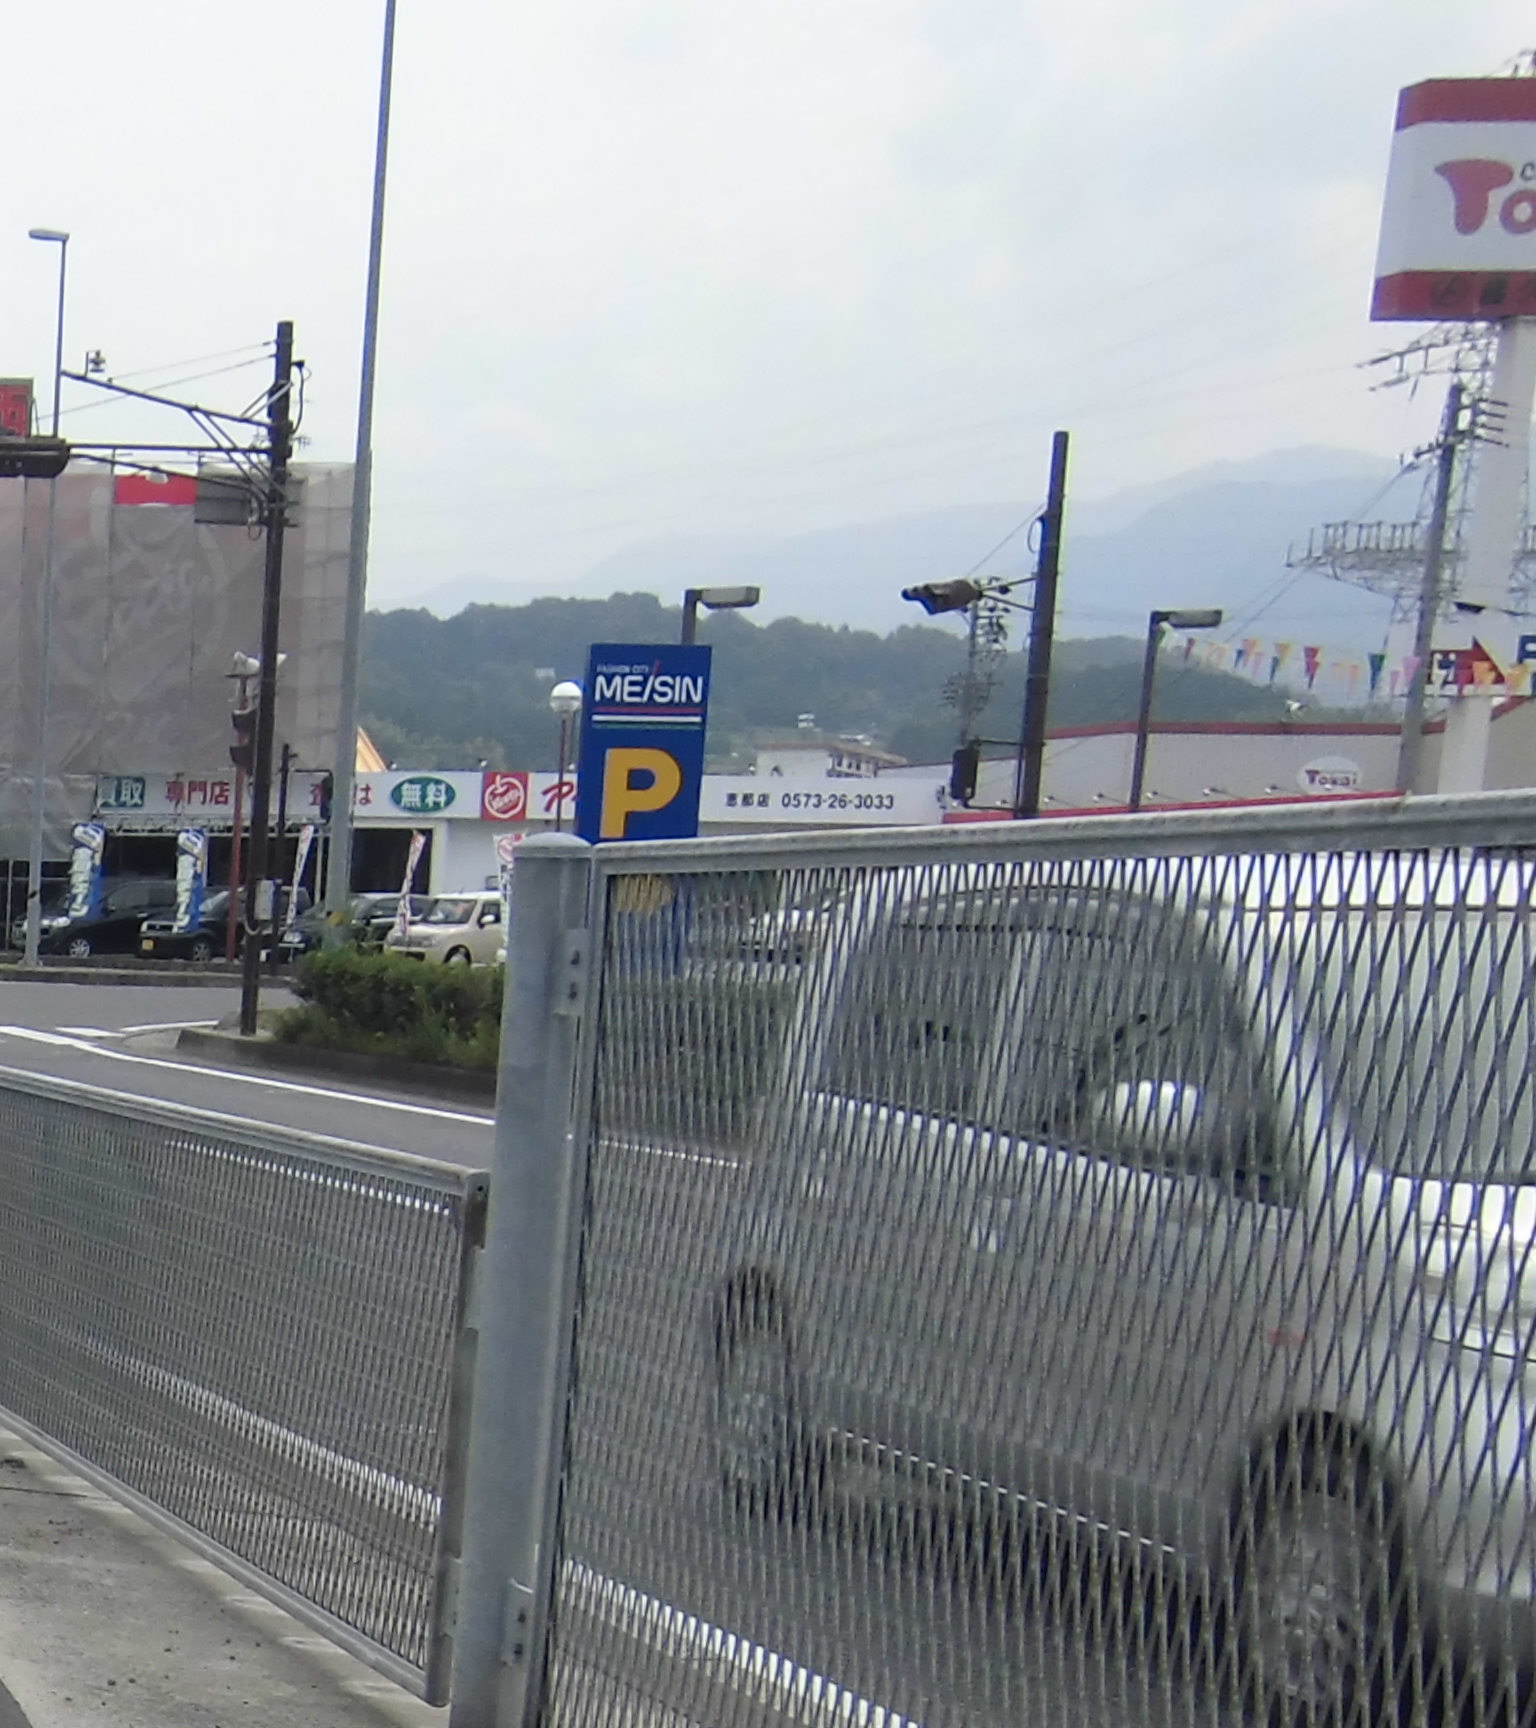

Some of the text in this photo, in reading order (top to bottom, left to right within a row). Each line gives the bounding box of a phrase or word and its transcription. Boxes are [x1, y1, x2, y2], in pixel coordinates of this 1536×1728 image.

[165, 779, 230, 807] 専門店
[400, 781, 448, 808] 無料
[781, 792, 895, 810] 0573-26-3033
[599, 747, 683, 839] P
